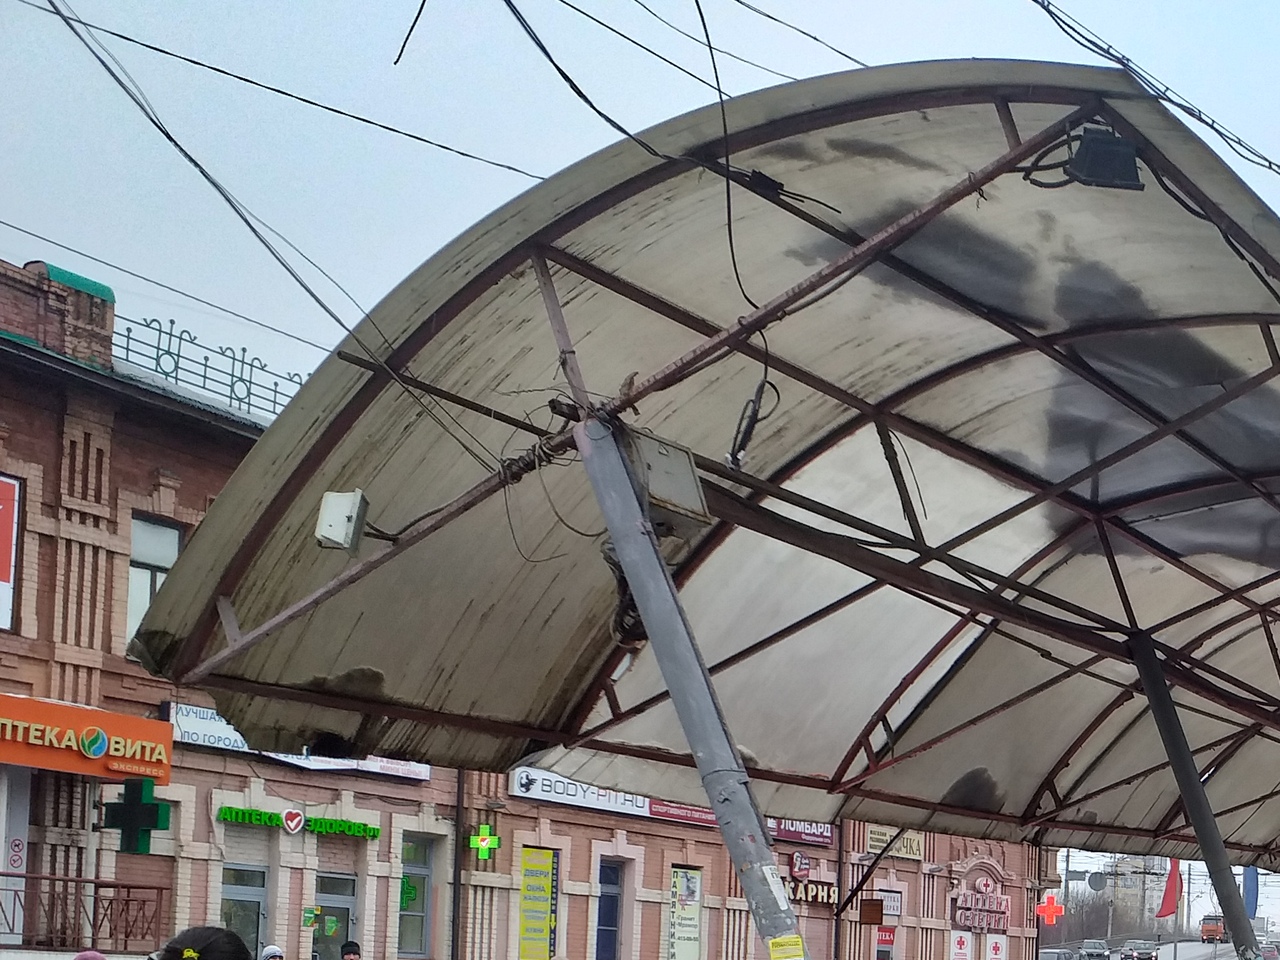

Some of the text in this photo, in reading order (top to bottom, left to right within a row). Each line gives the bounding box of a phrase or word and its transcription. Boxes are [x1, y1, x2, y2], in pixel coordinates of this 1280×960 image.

[183, 730, 246, 748] ПО ГОРОДУ
[109, 736, 168, 764] ВИТА
[112, 763, 165, 776] ЭКСПРЕСС
[217, 806, 283, 827] АПТЕКА
[780, 819, 832, 836] ЛОМБАРД
[670, 870, 679, 960] ПАМЯТНИКИ
